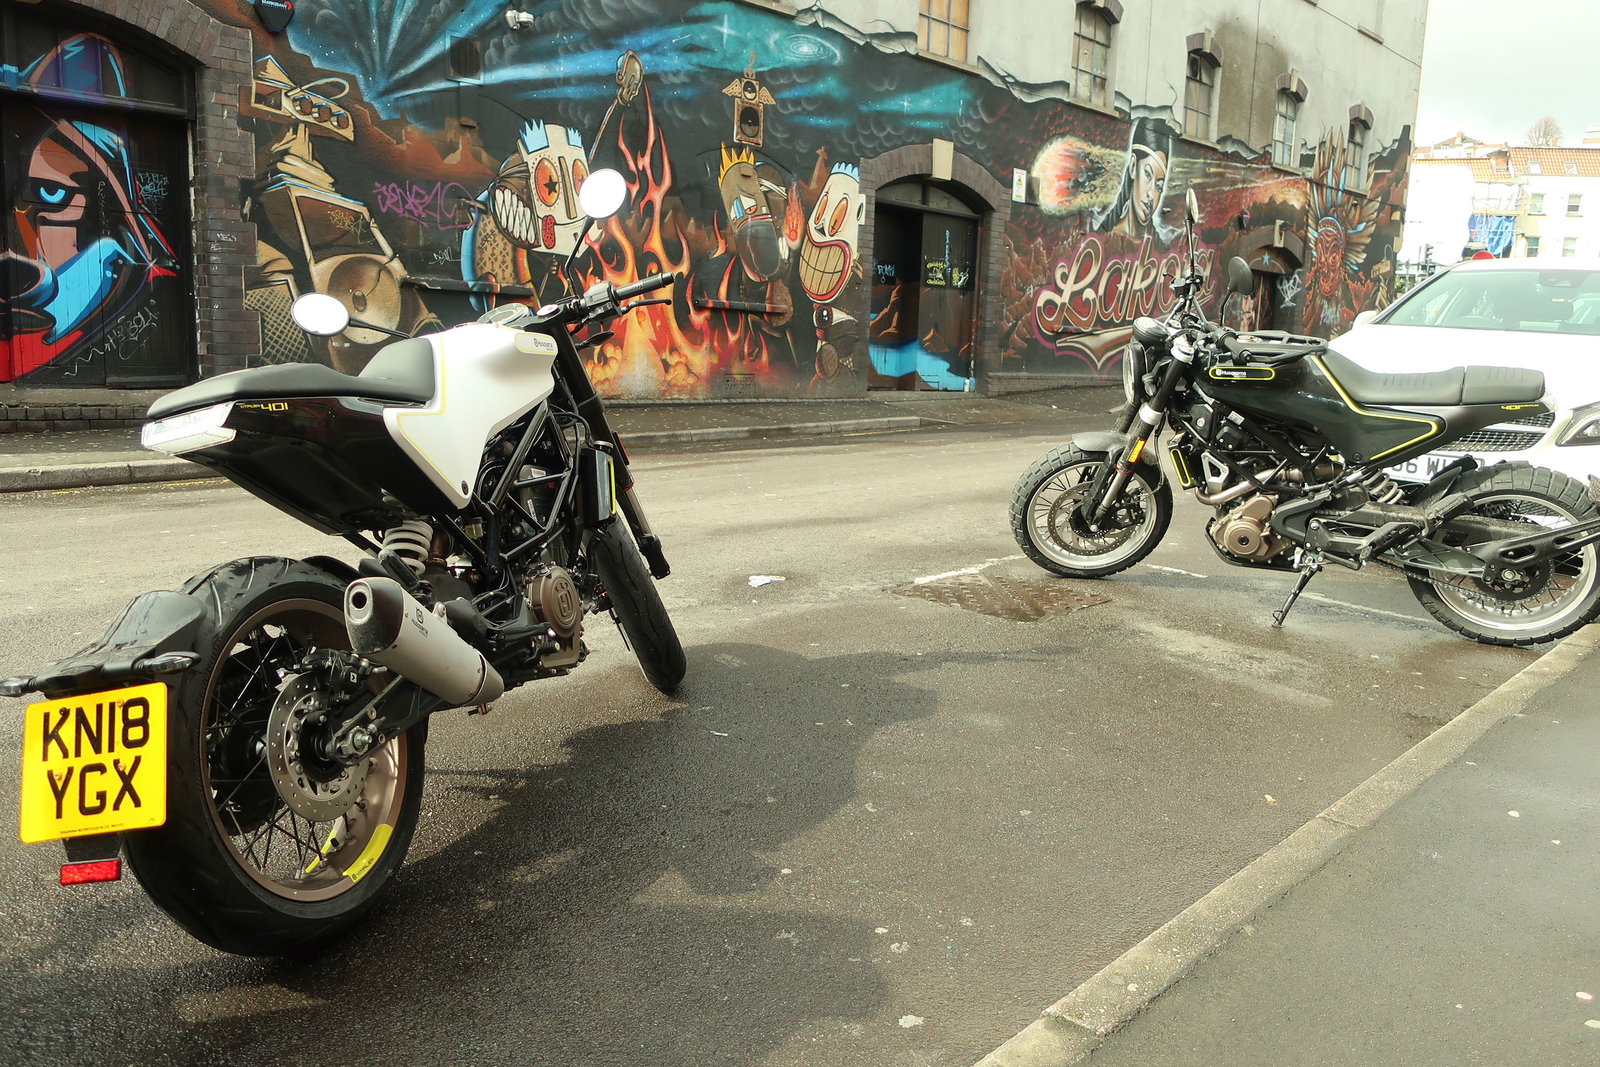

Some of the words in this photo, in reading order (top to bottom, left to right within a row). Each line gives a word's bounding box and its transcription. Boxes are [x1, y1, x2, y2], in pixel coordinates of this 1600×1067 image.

[261, 402, 288, 411] 401
[42, 696, 150, 762] KN18
[47, 755, 142, 819] YGX
